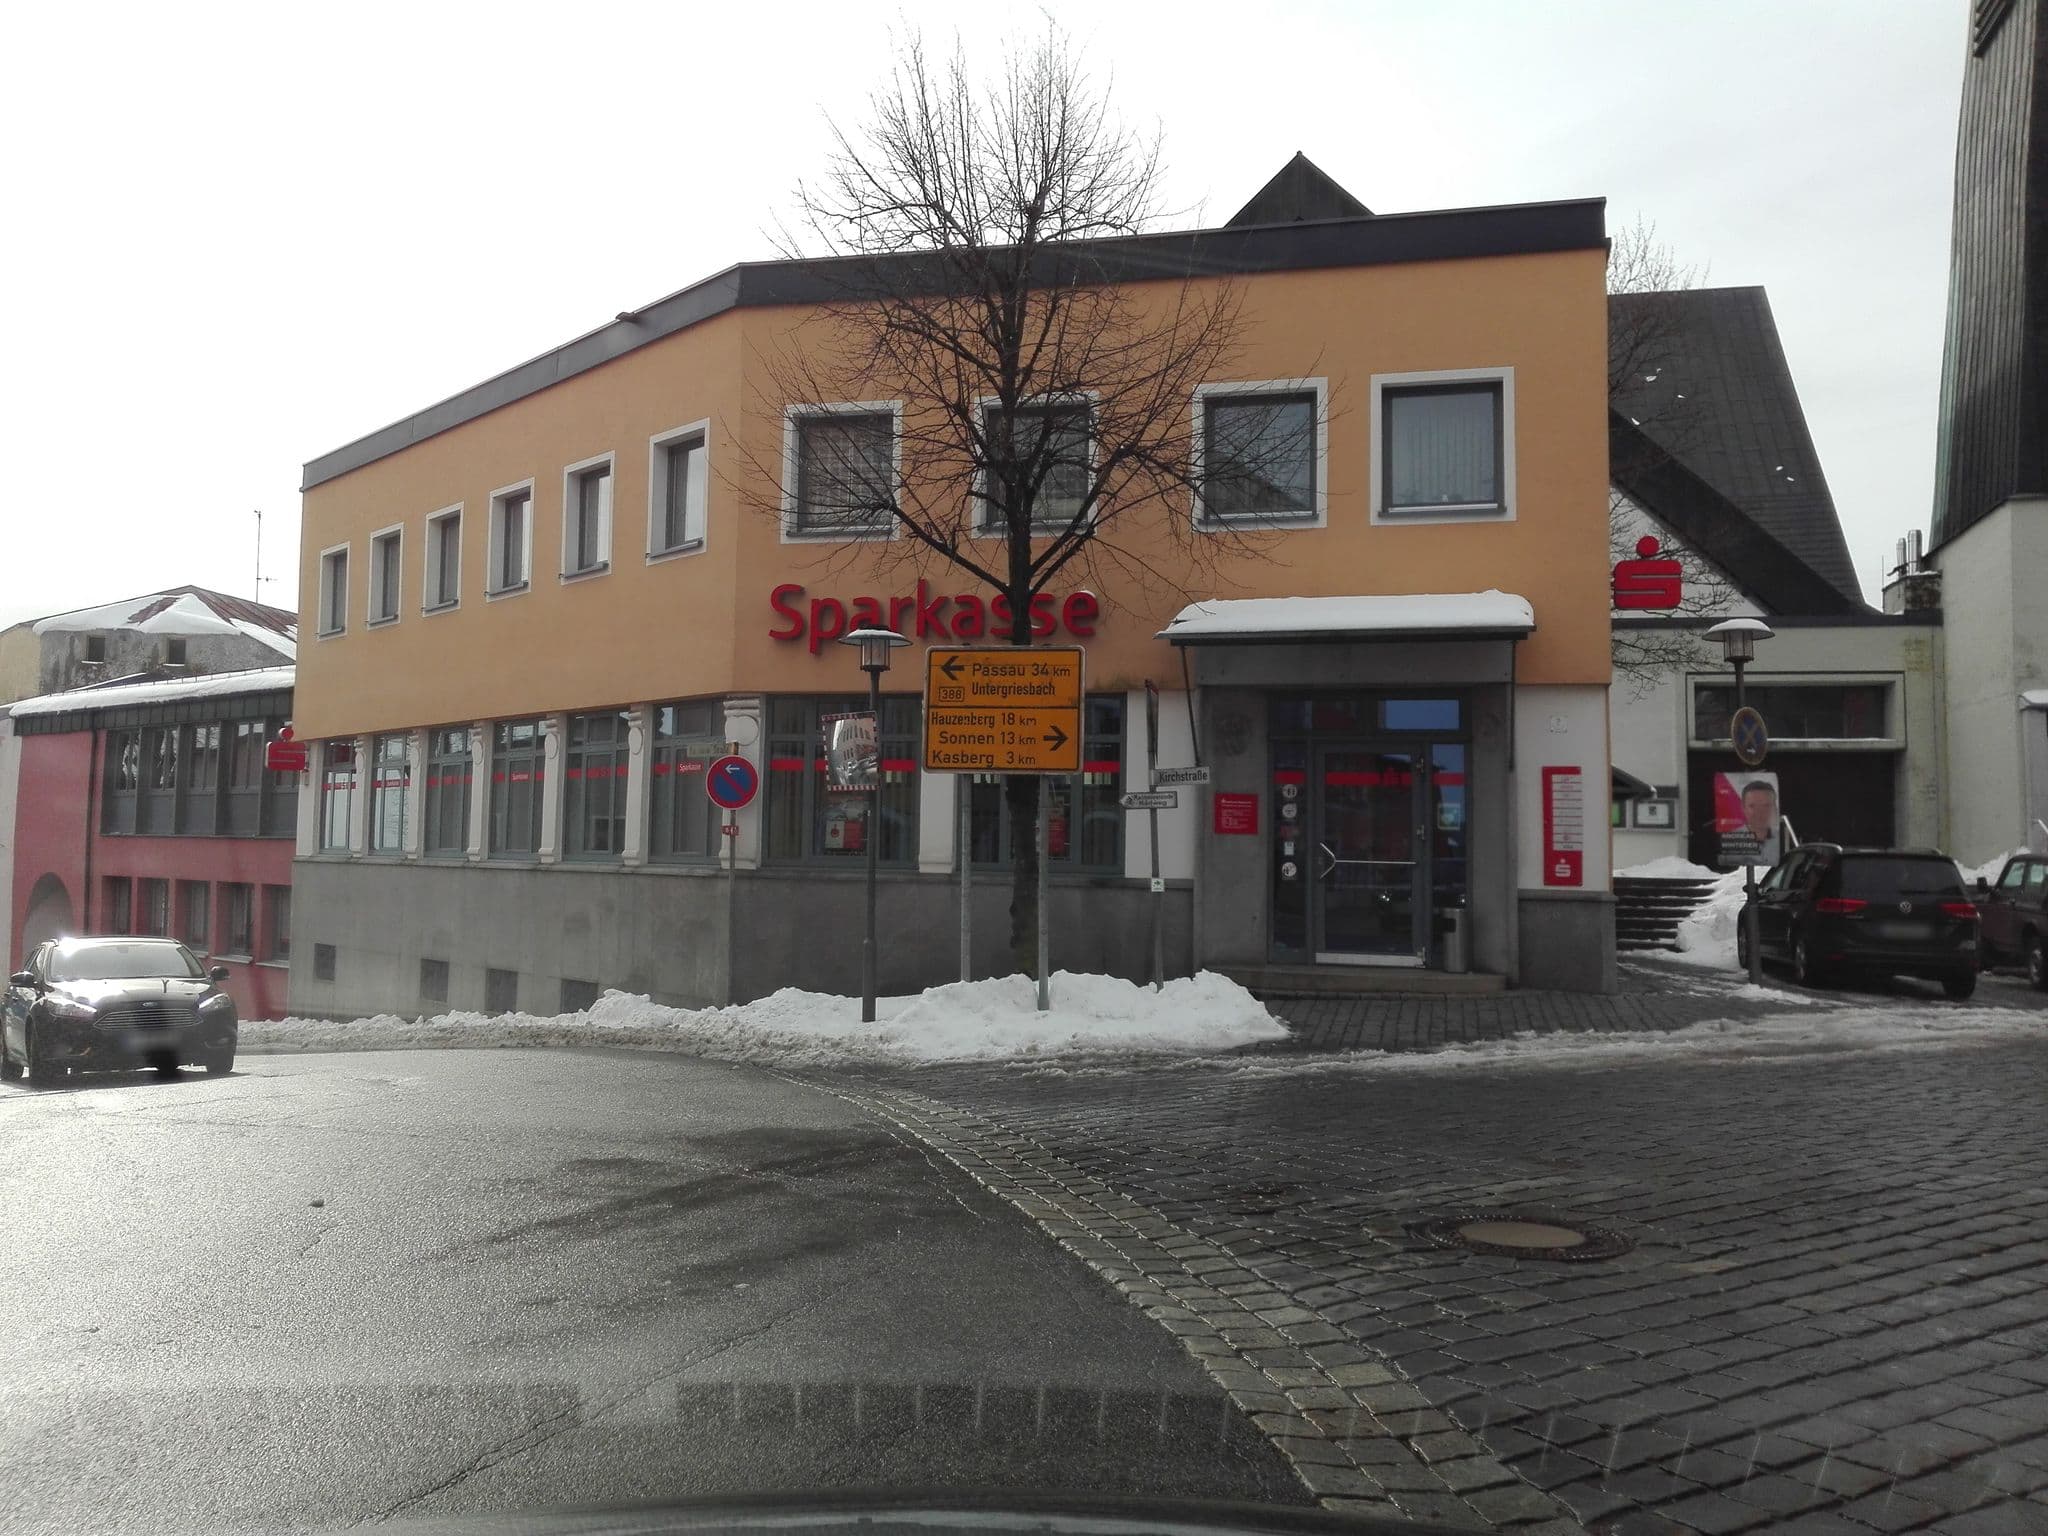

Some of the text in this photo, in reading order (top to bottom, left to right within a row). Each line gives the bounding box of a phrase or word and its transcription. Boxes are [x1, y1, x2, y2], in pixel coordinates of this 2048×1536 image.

[768, 577, 1100, 656] Sparkasse
[972, 662, 1071, 677] Passau 34 km
[941, 681, 1056, 700] 388 Untergriesbach
[931, 711, 1037, 728] Hauzenberg 18 km
[938, 730, 1037, 745] Sonnen 13 km
[932, 749, 1036, 766] Kasberg 3 km
[1159, 769, 1208, 783] Kirchstraße
